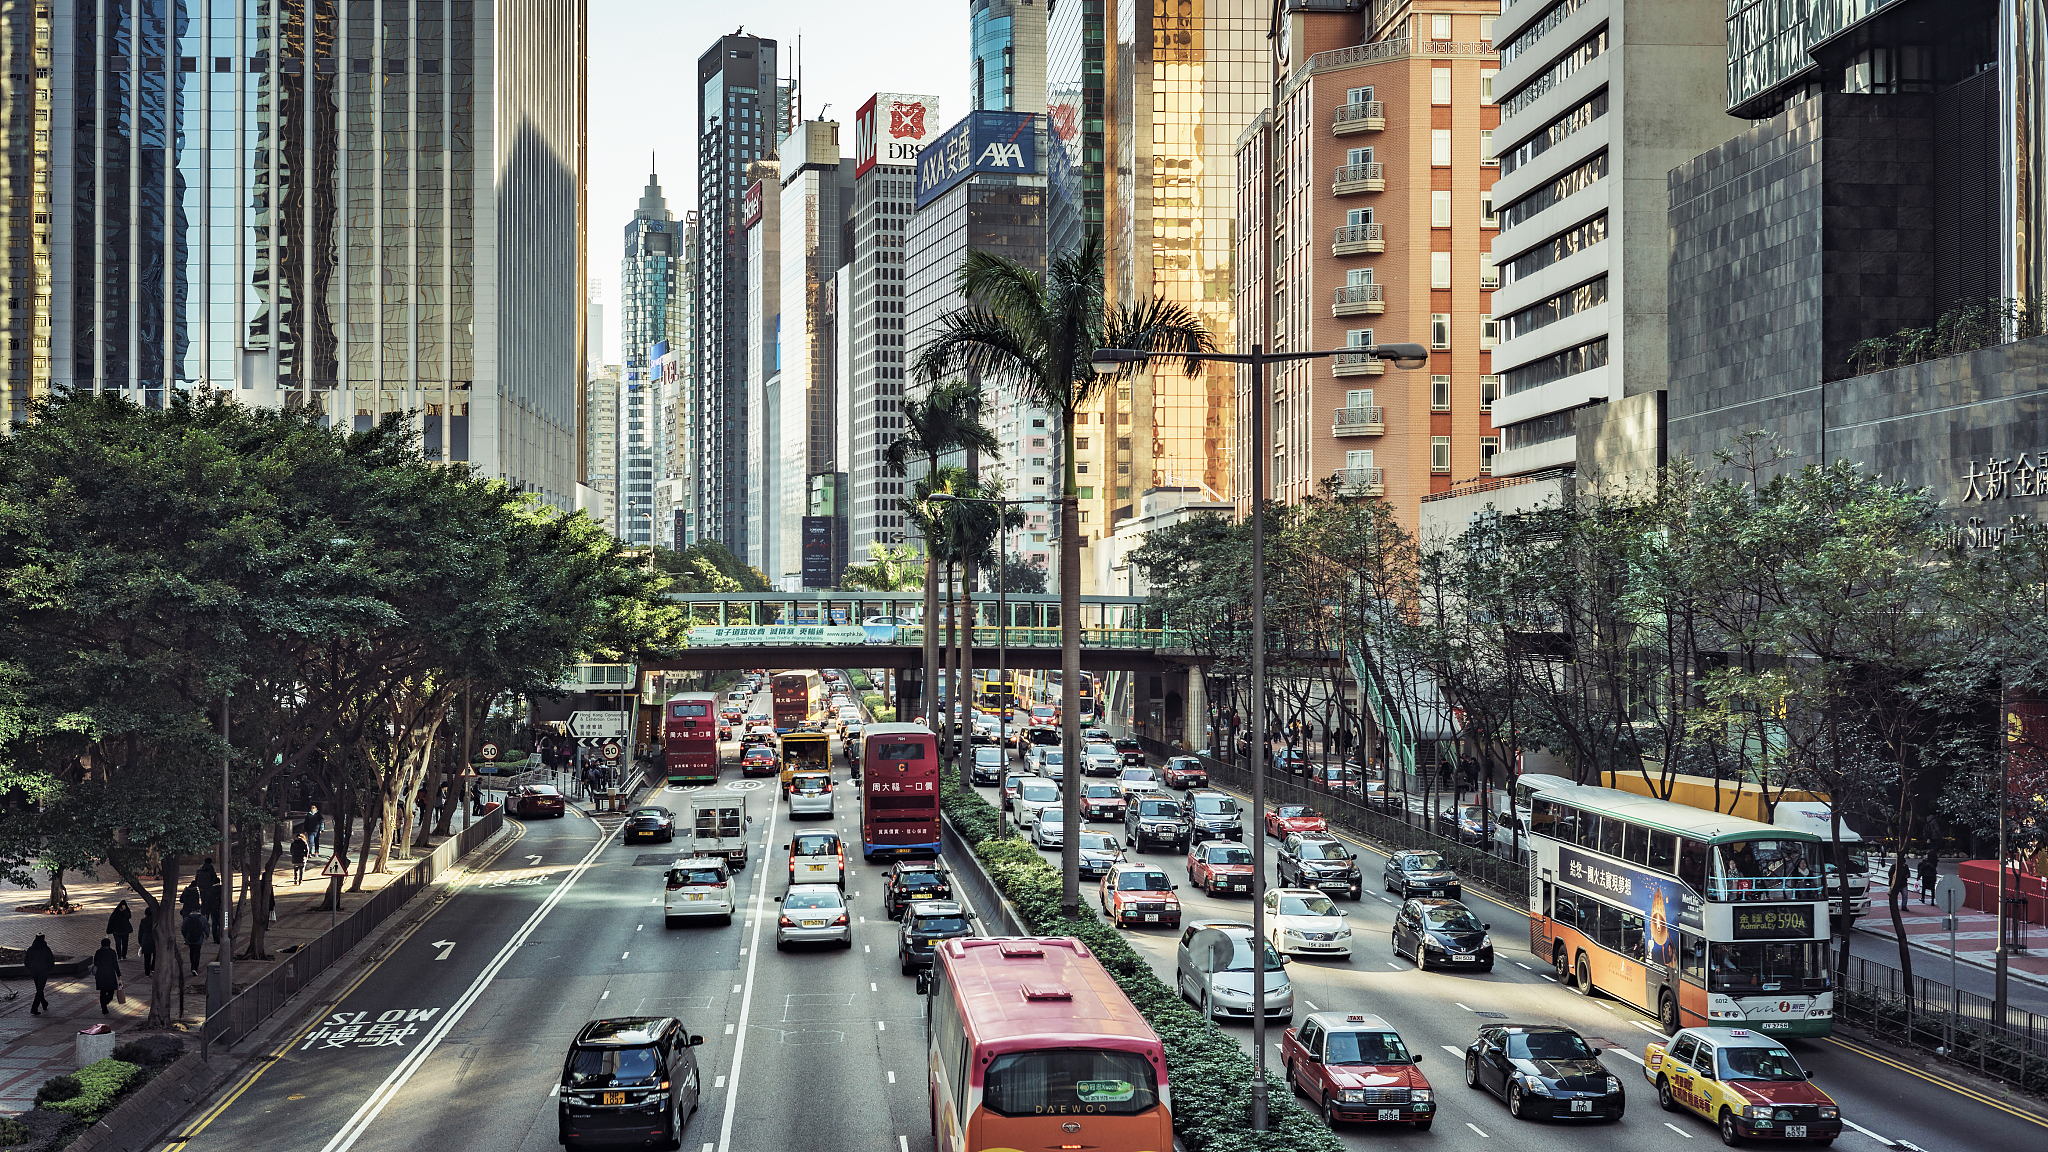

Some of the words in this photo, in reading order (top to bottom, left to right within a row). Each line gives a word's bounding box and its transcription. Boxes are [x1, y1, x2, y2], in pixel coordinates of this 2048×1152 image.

[921, 149, 946, 195] AXA
[946, 125, 970, 180] 安盛
[975, 142, 1025, 168] AXA
[663, 360, 679, 385] TCL
[715, 628, 766, 636] 電子道路收費
[669, 731, 689, 739] 周大福
[483, 747, 496, 756] 50
[605, 747, 617, 755] 50
[872, 782, 900, 792] 周大福
[905, 782, 933, 791] 一口價
[486, 869, 559, 877] SLOW
[1777, 913, 1805, 929] 590A
[323, 1007, 441, 1026] SLOW
[300, 1022, 419, 1051] 慢駛
[1035, 1104, 1107, 1114] DAEWOO
